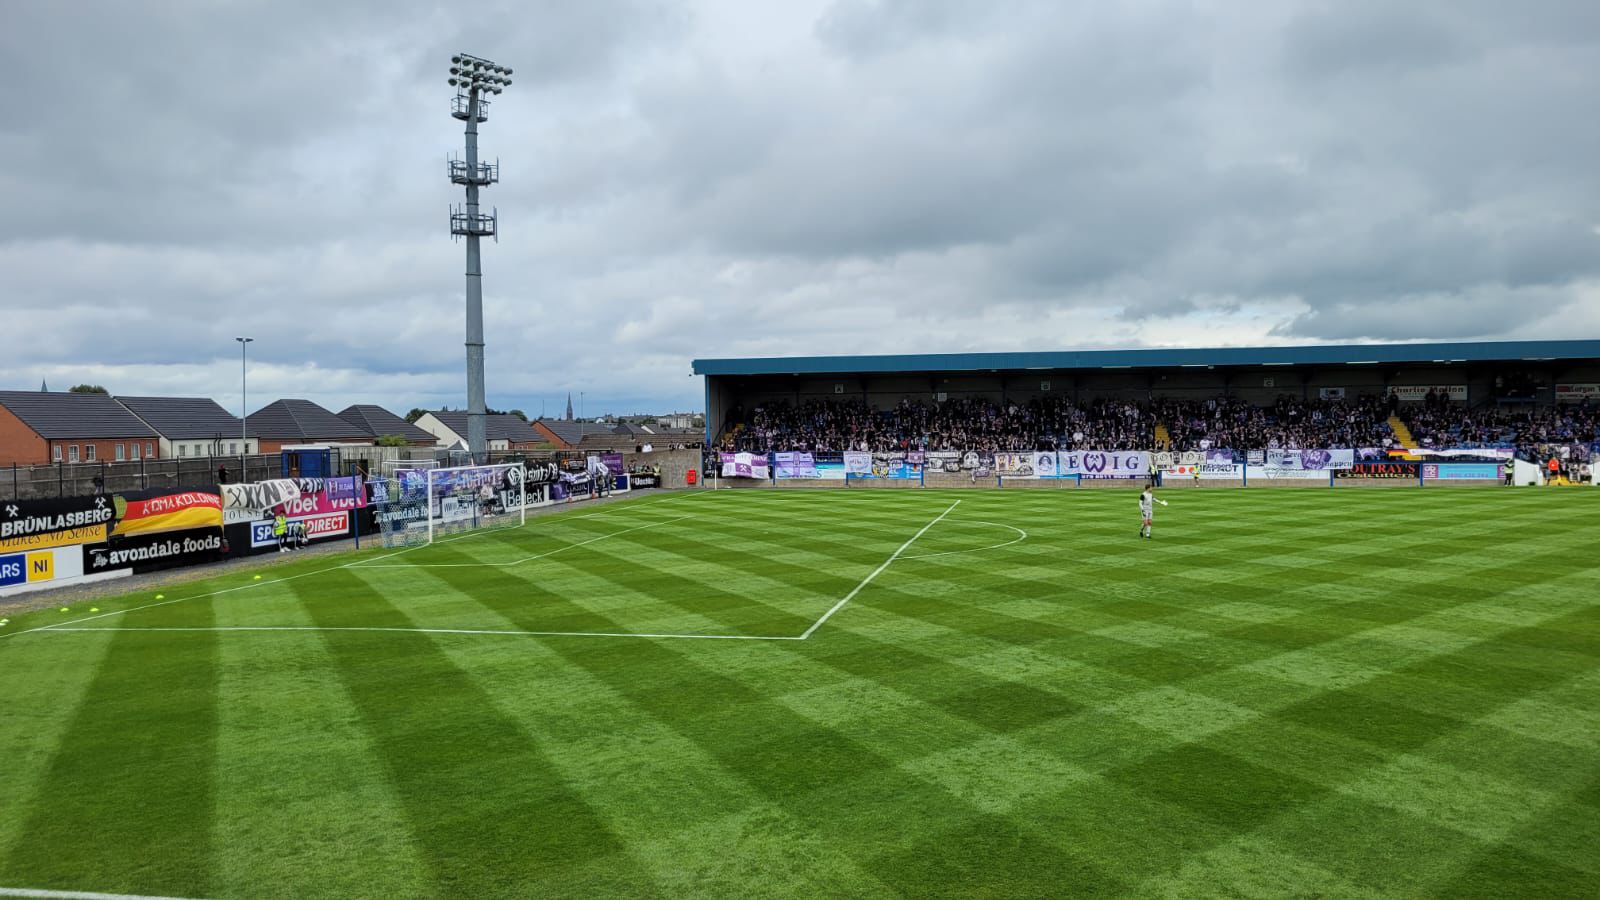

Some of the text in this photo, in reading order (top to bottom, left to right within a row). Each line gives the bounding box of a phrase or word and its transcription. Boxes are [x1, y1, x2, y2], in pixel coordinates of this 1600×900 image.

[507, 488, 544, 508] Beeck
[1, 508, 112, 538] BRÜNLASBERG
[109, 535, 221, 564] avondale foods
[34, 559, 48, 574] NI
